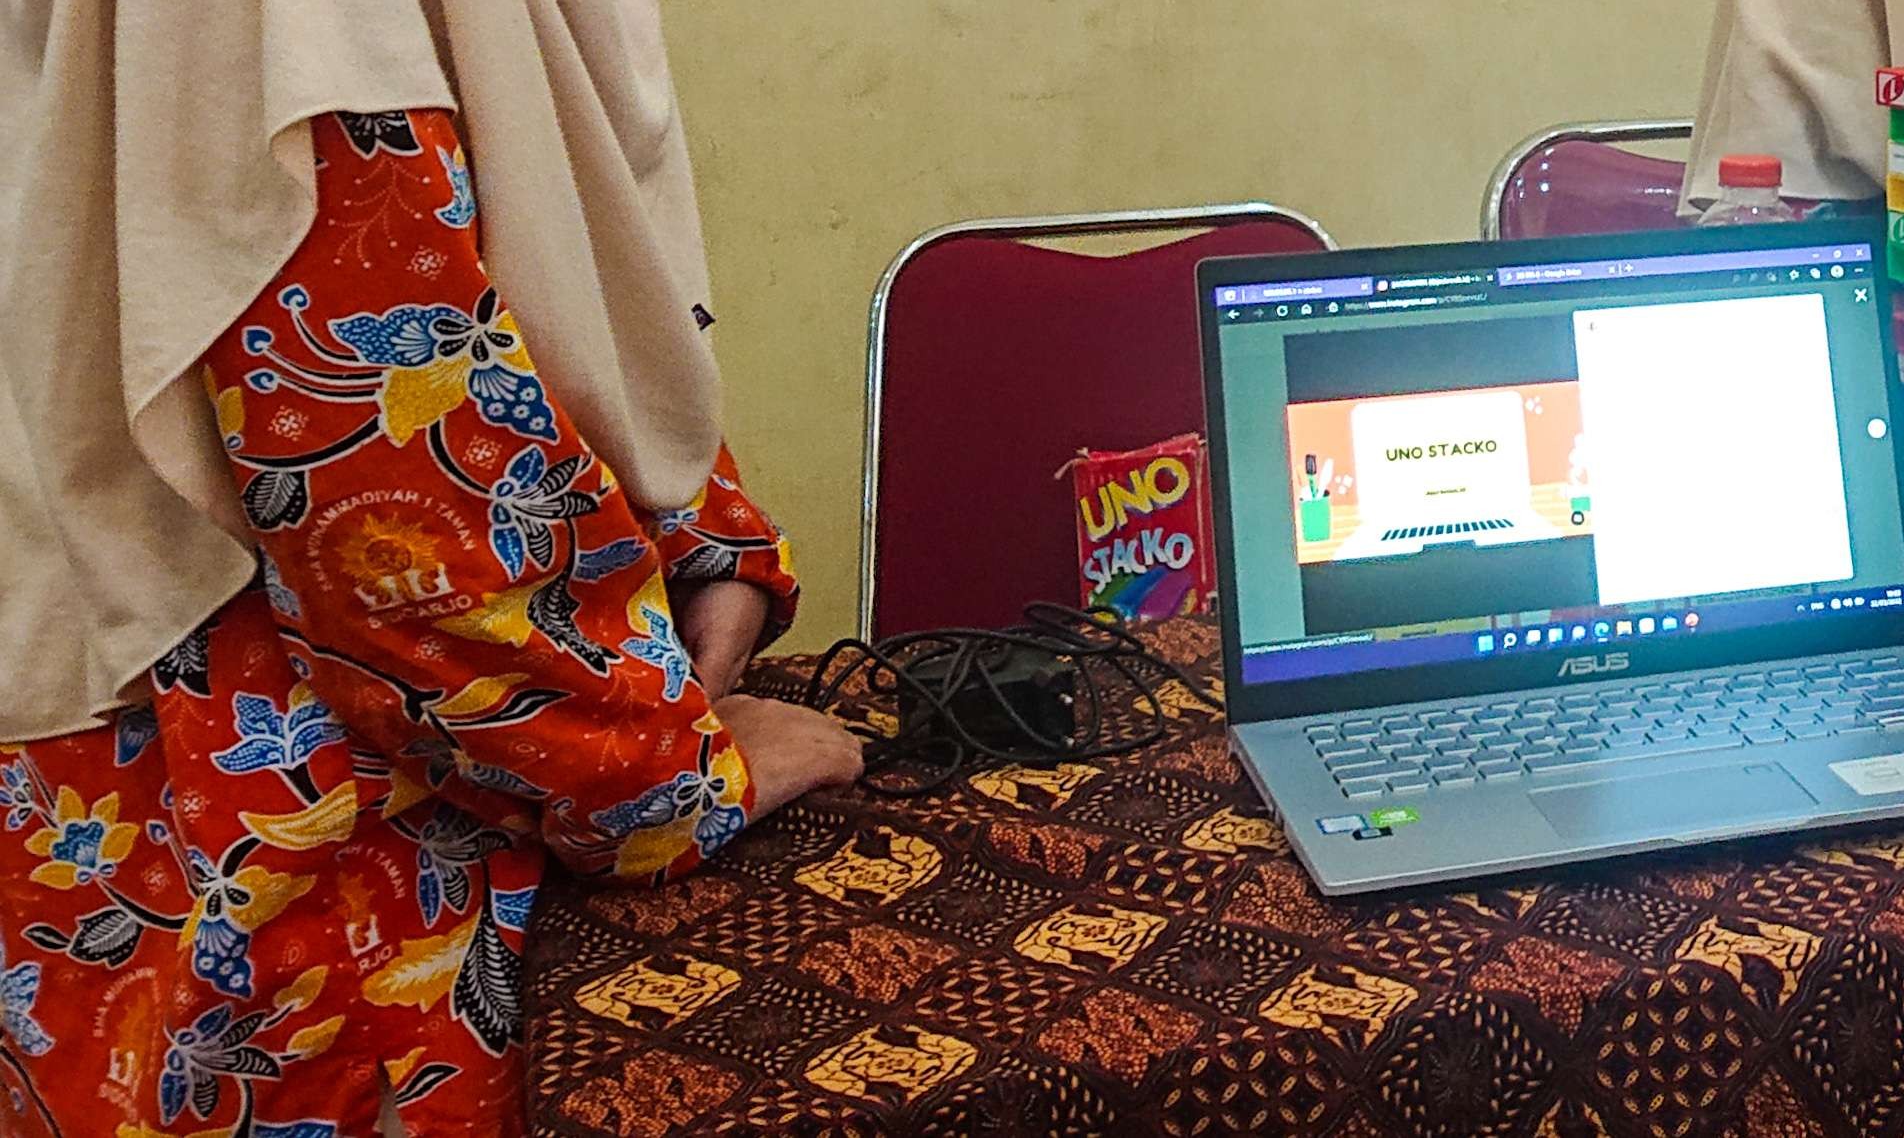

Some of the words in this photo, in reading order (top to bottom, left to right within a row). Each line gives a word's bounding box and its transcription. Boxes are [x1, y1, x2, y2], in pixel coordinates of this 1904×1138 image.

[1385, 446, 1424, 462] UNO
[1428, 439, 1498, 458] STACKO
[1079, 456, 1191, 542] UNO
[436, 502, 477, 551] TAMAN
[1083, 527, 1195, 595] STACKO
[1557, 652, 1630, 678] ASUS
